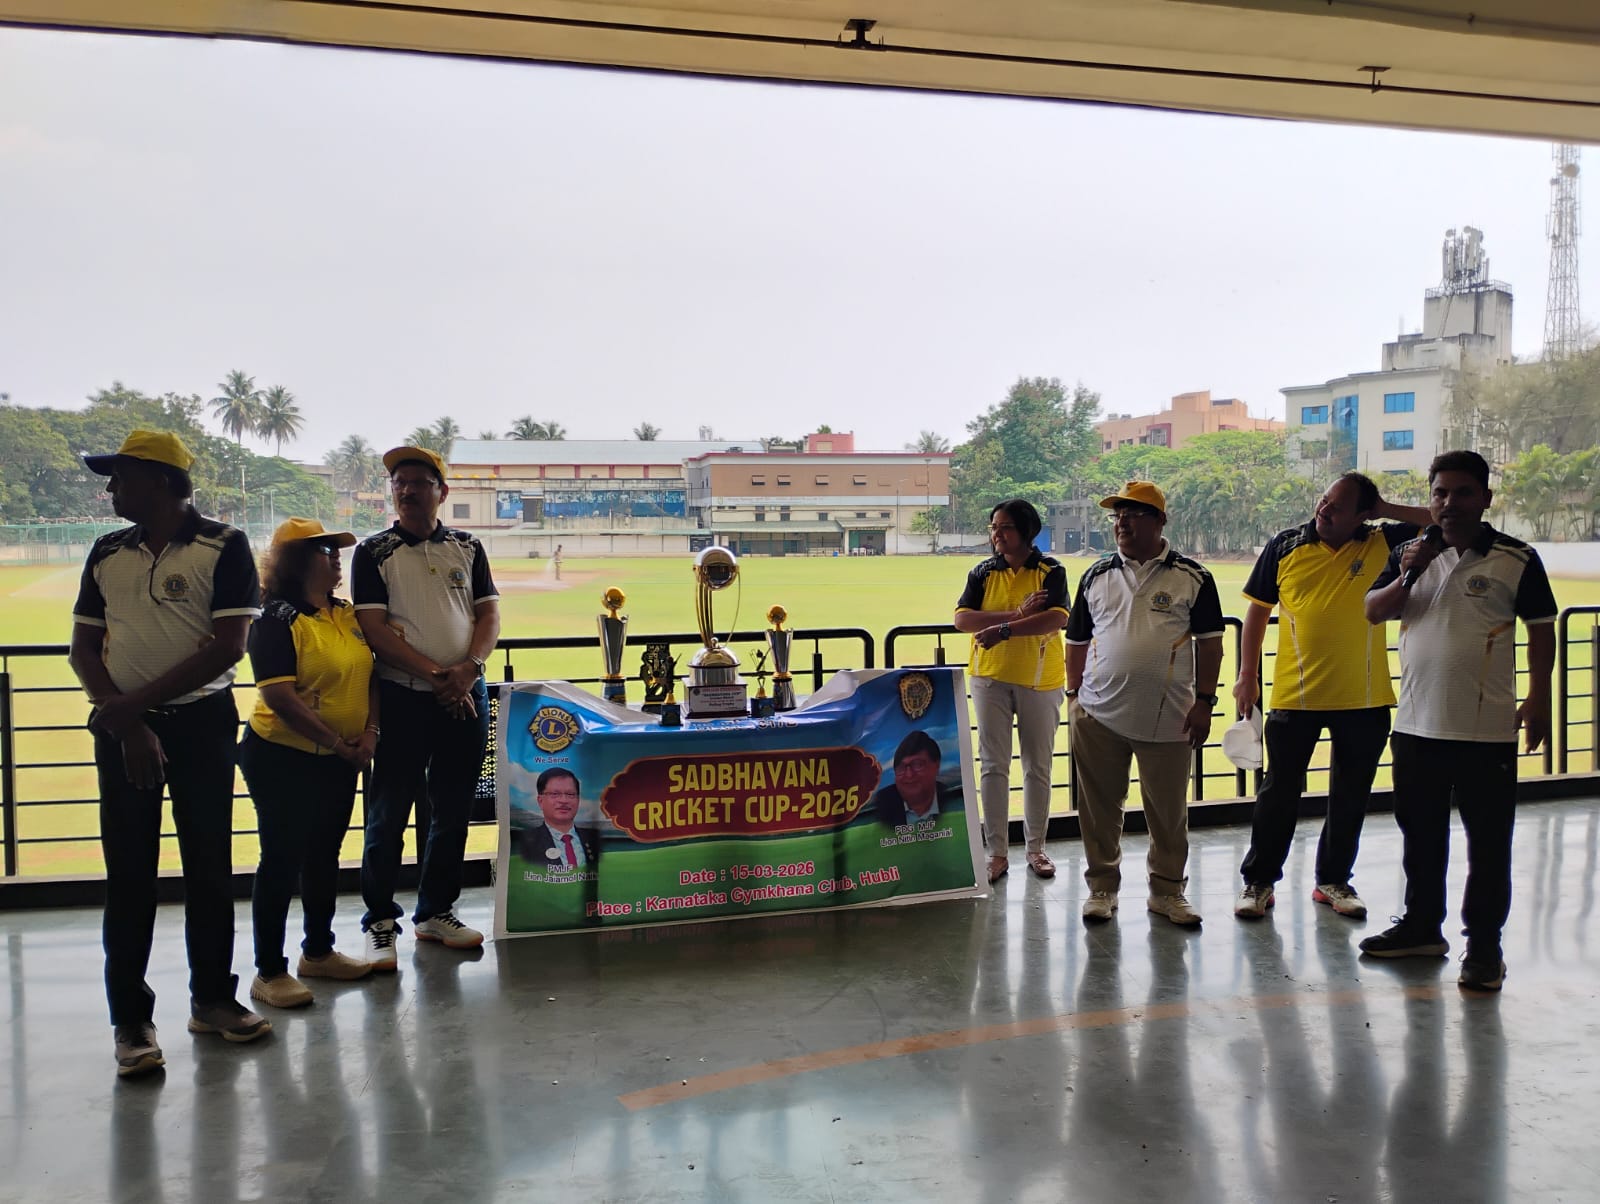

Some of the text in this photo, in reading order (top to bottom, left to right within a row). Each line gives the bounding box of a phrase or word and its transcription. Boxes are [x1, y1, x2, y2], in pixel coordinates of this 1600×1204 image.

[541, 708, 571, 722] LIONS
[547, 721, 561, 735] L
[547, 756, 569, 764] Serve
[668, 758, 830, 793] SADBHAVANA
[633, 785, 859, 831] CRICKET CUP-2026
[918, 820, 936, 831] MJF
[880, 837, 897, 847] Lion
[547, 864, 573, 873] PMJF
[680, 869, 716, 885] Date
[731, 861, 815, 880] 15-03-2026
[524, 871, 542, 881] Lion
[586, 901, 632, 917] Place
[645, 891, 727, 911] Karnataka
[731, 883, 814, 905] Gymkhana
[817, 876, 857, 894] Club,
[859, 866, 900, 886] Hubli
